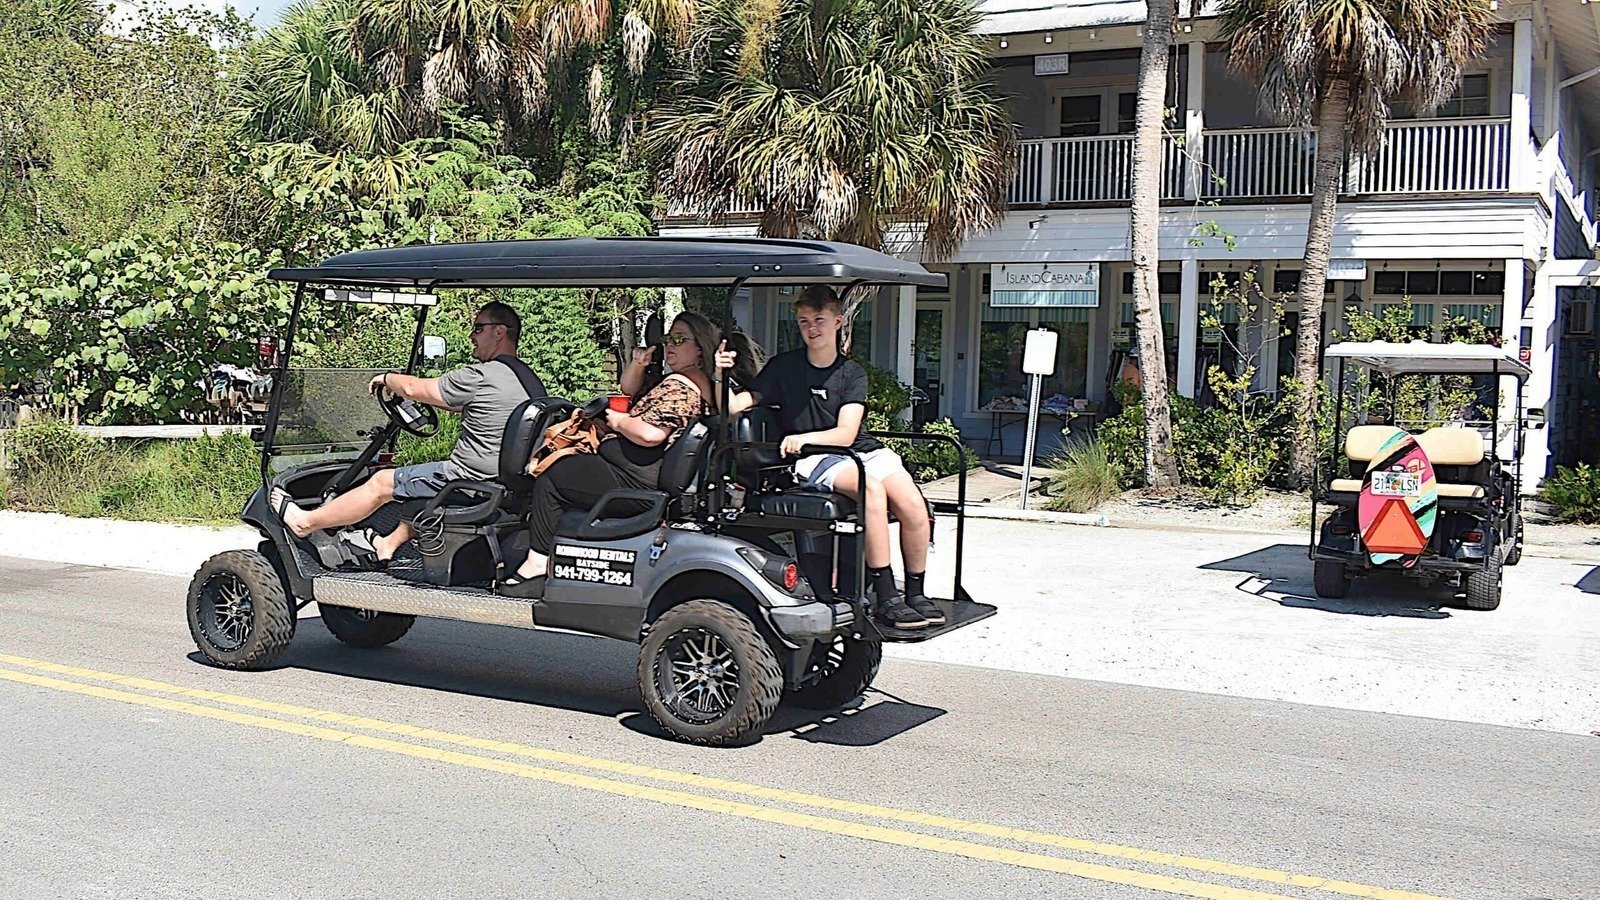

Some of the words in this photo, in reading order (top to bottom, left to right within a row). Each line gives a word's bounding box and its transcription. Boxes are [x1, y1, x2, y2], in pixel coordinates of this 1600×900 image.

[599, 549, 635, 563] RENTALS
[576, 559, 610, 569] BAYSIDE
[555, 564, 632, 586] 941-799-1264
